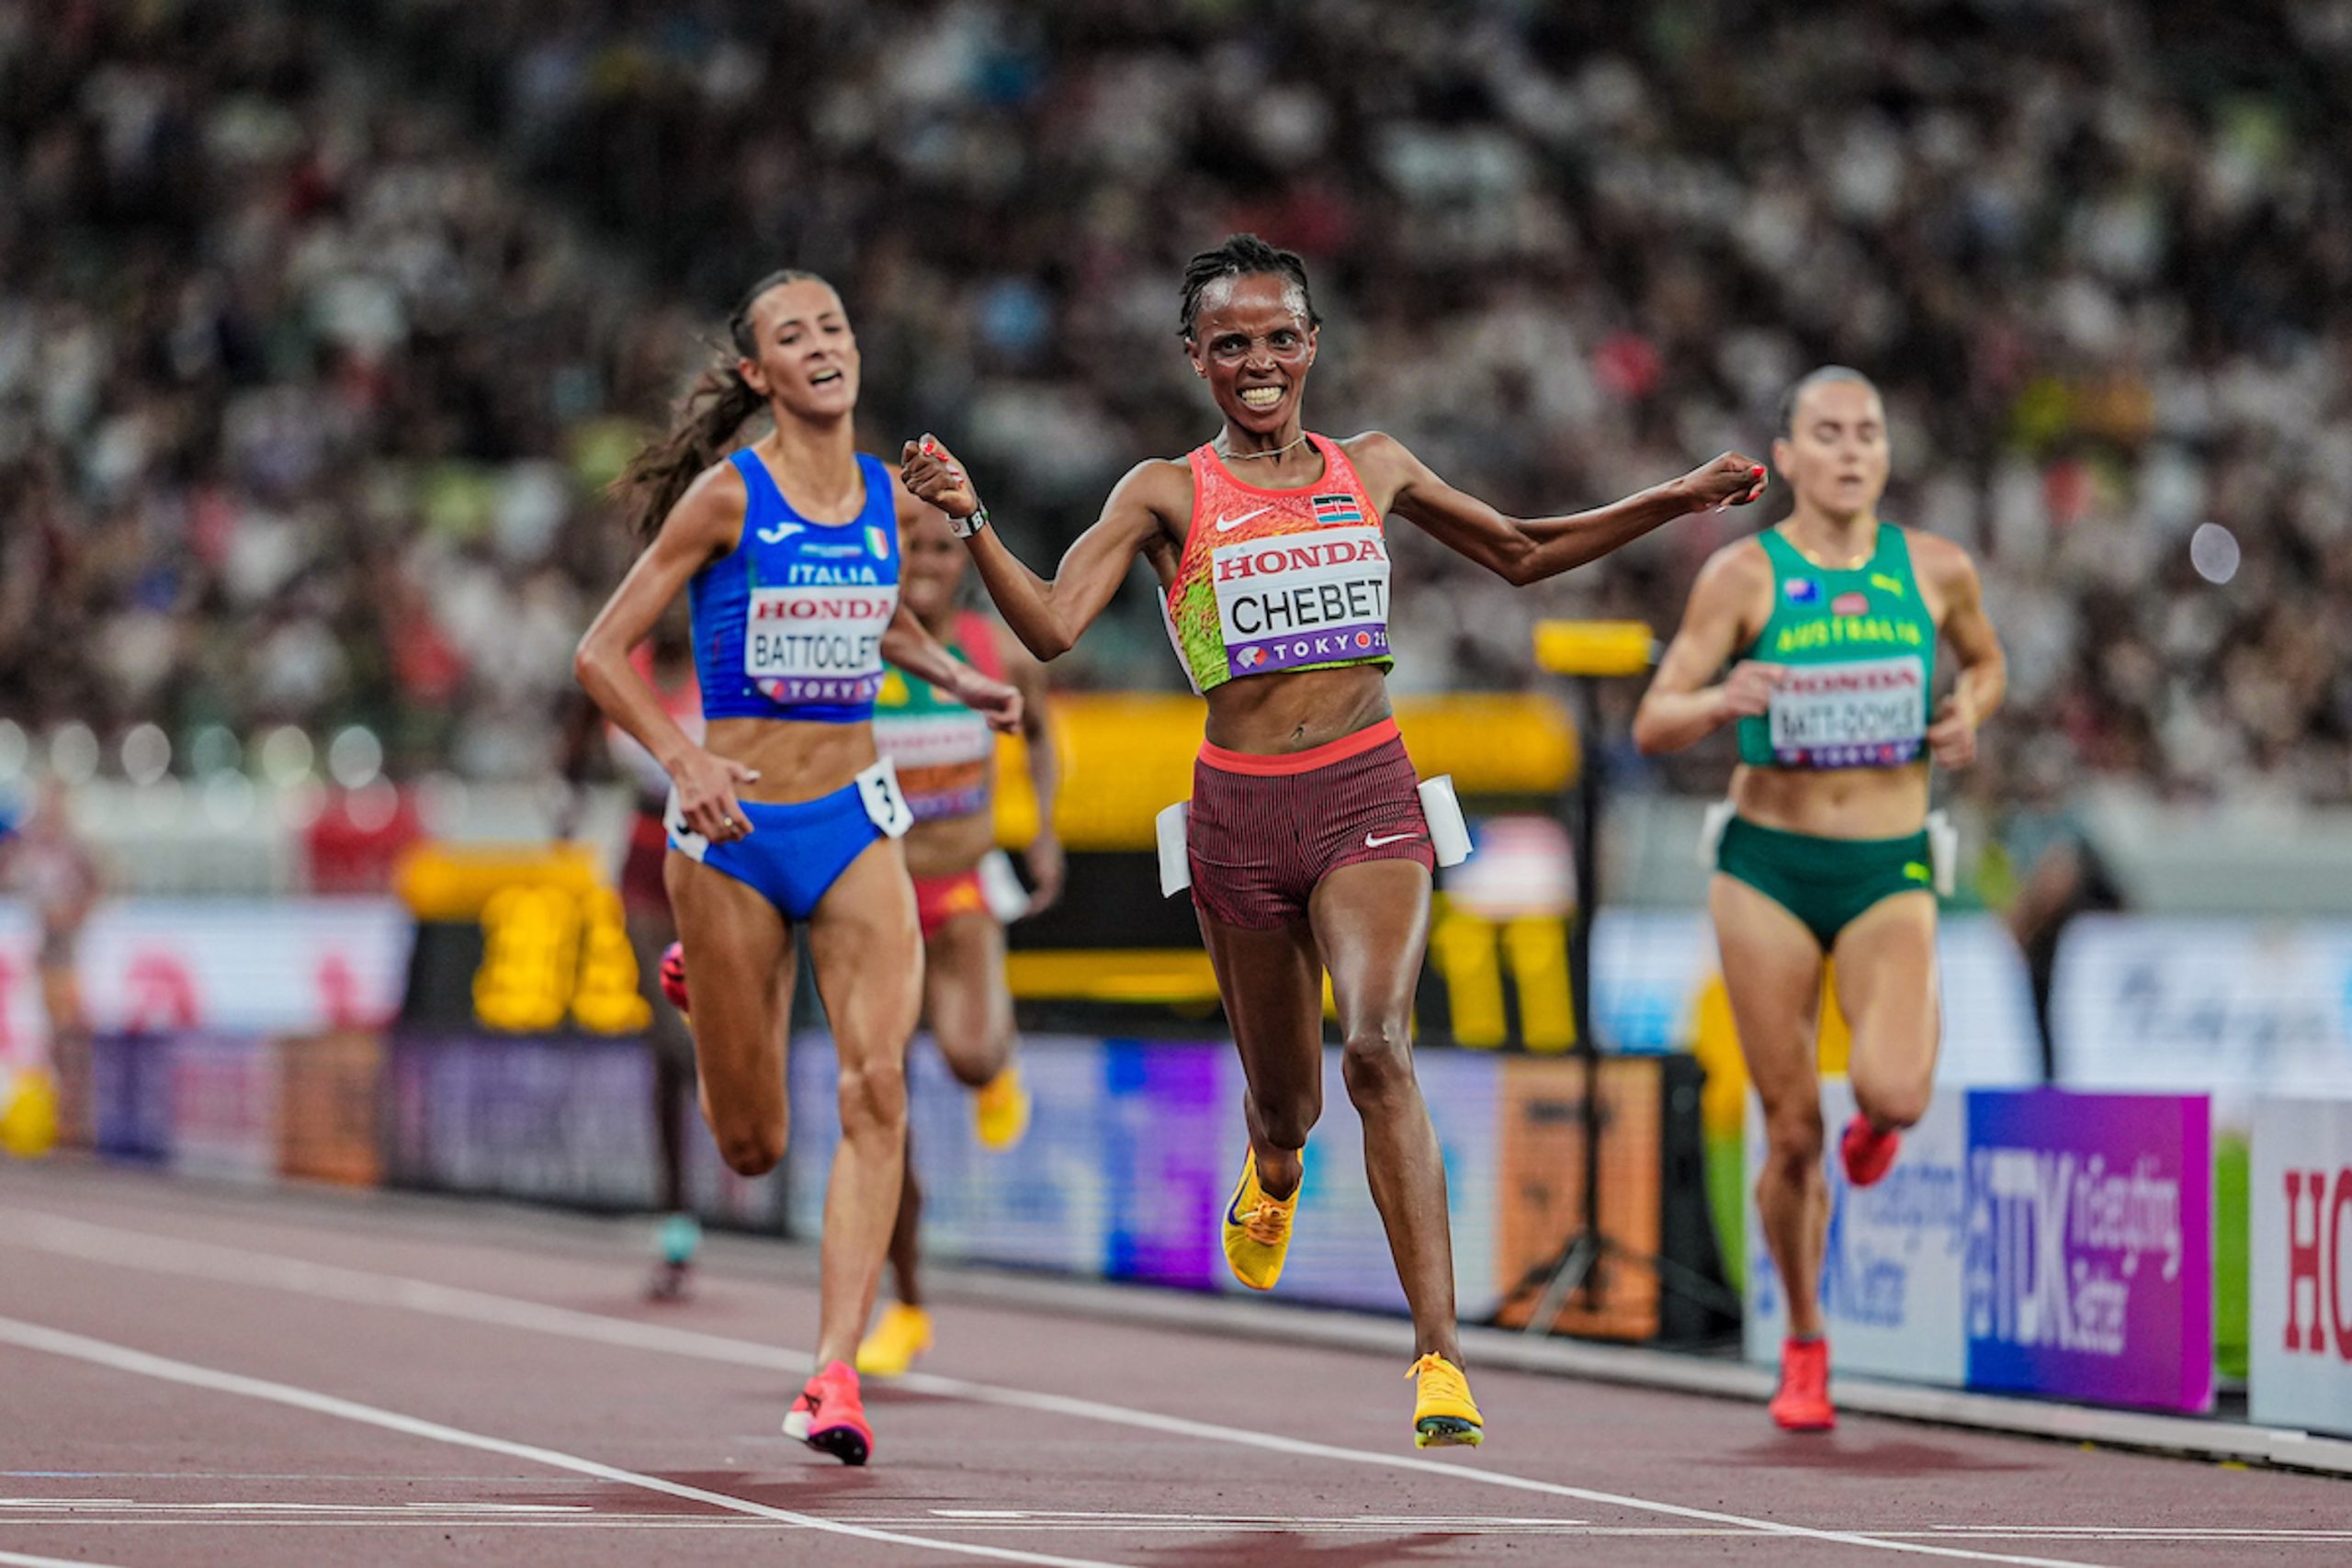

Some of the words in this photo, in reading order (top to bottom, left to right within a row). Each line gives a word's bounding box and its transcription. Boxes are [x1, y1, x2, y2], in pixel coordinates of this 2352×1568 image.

[787, 561, 878, 584] ITALIA
[1217, 539, 1385, 582] HONDA
[756, 599, 892, 621] HONDA
[1232, 580, 1383, 635] CHEBET
[1775, 615, 1923, 654] AUSTRALIA
[875, 777, 895, 823] 3
